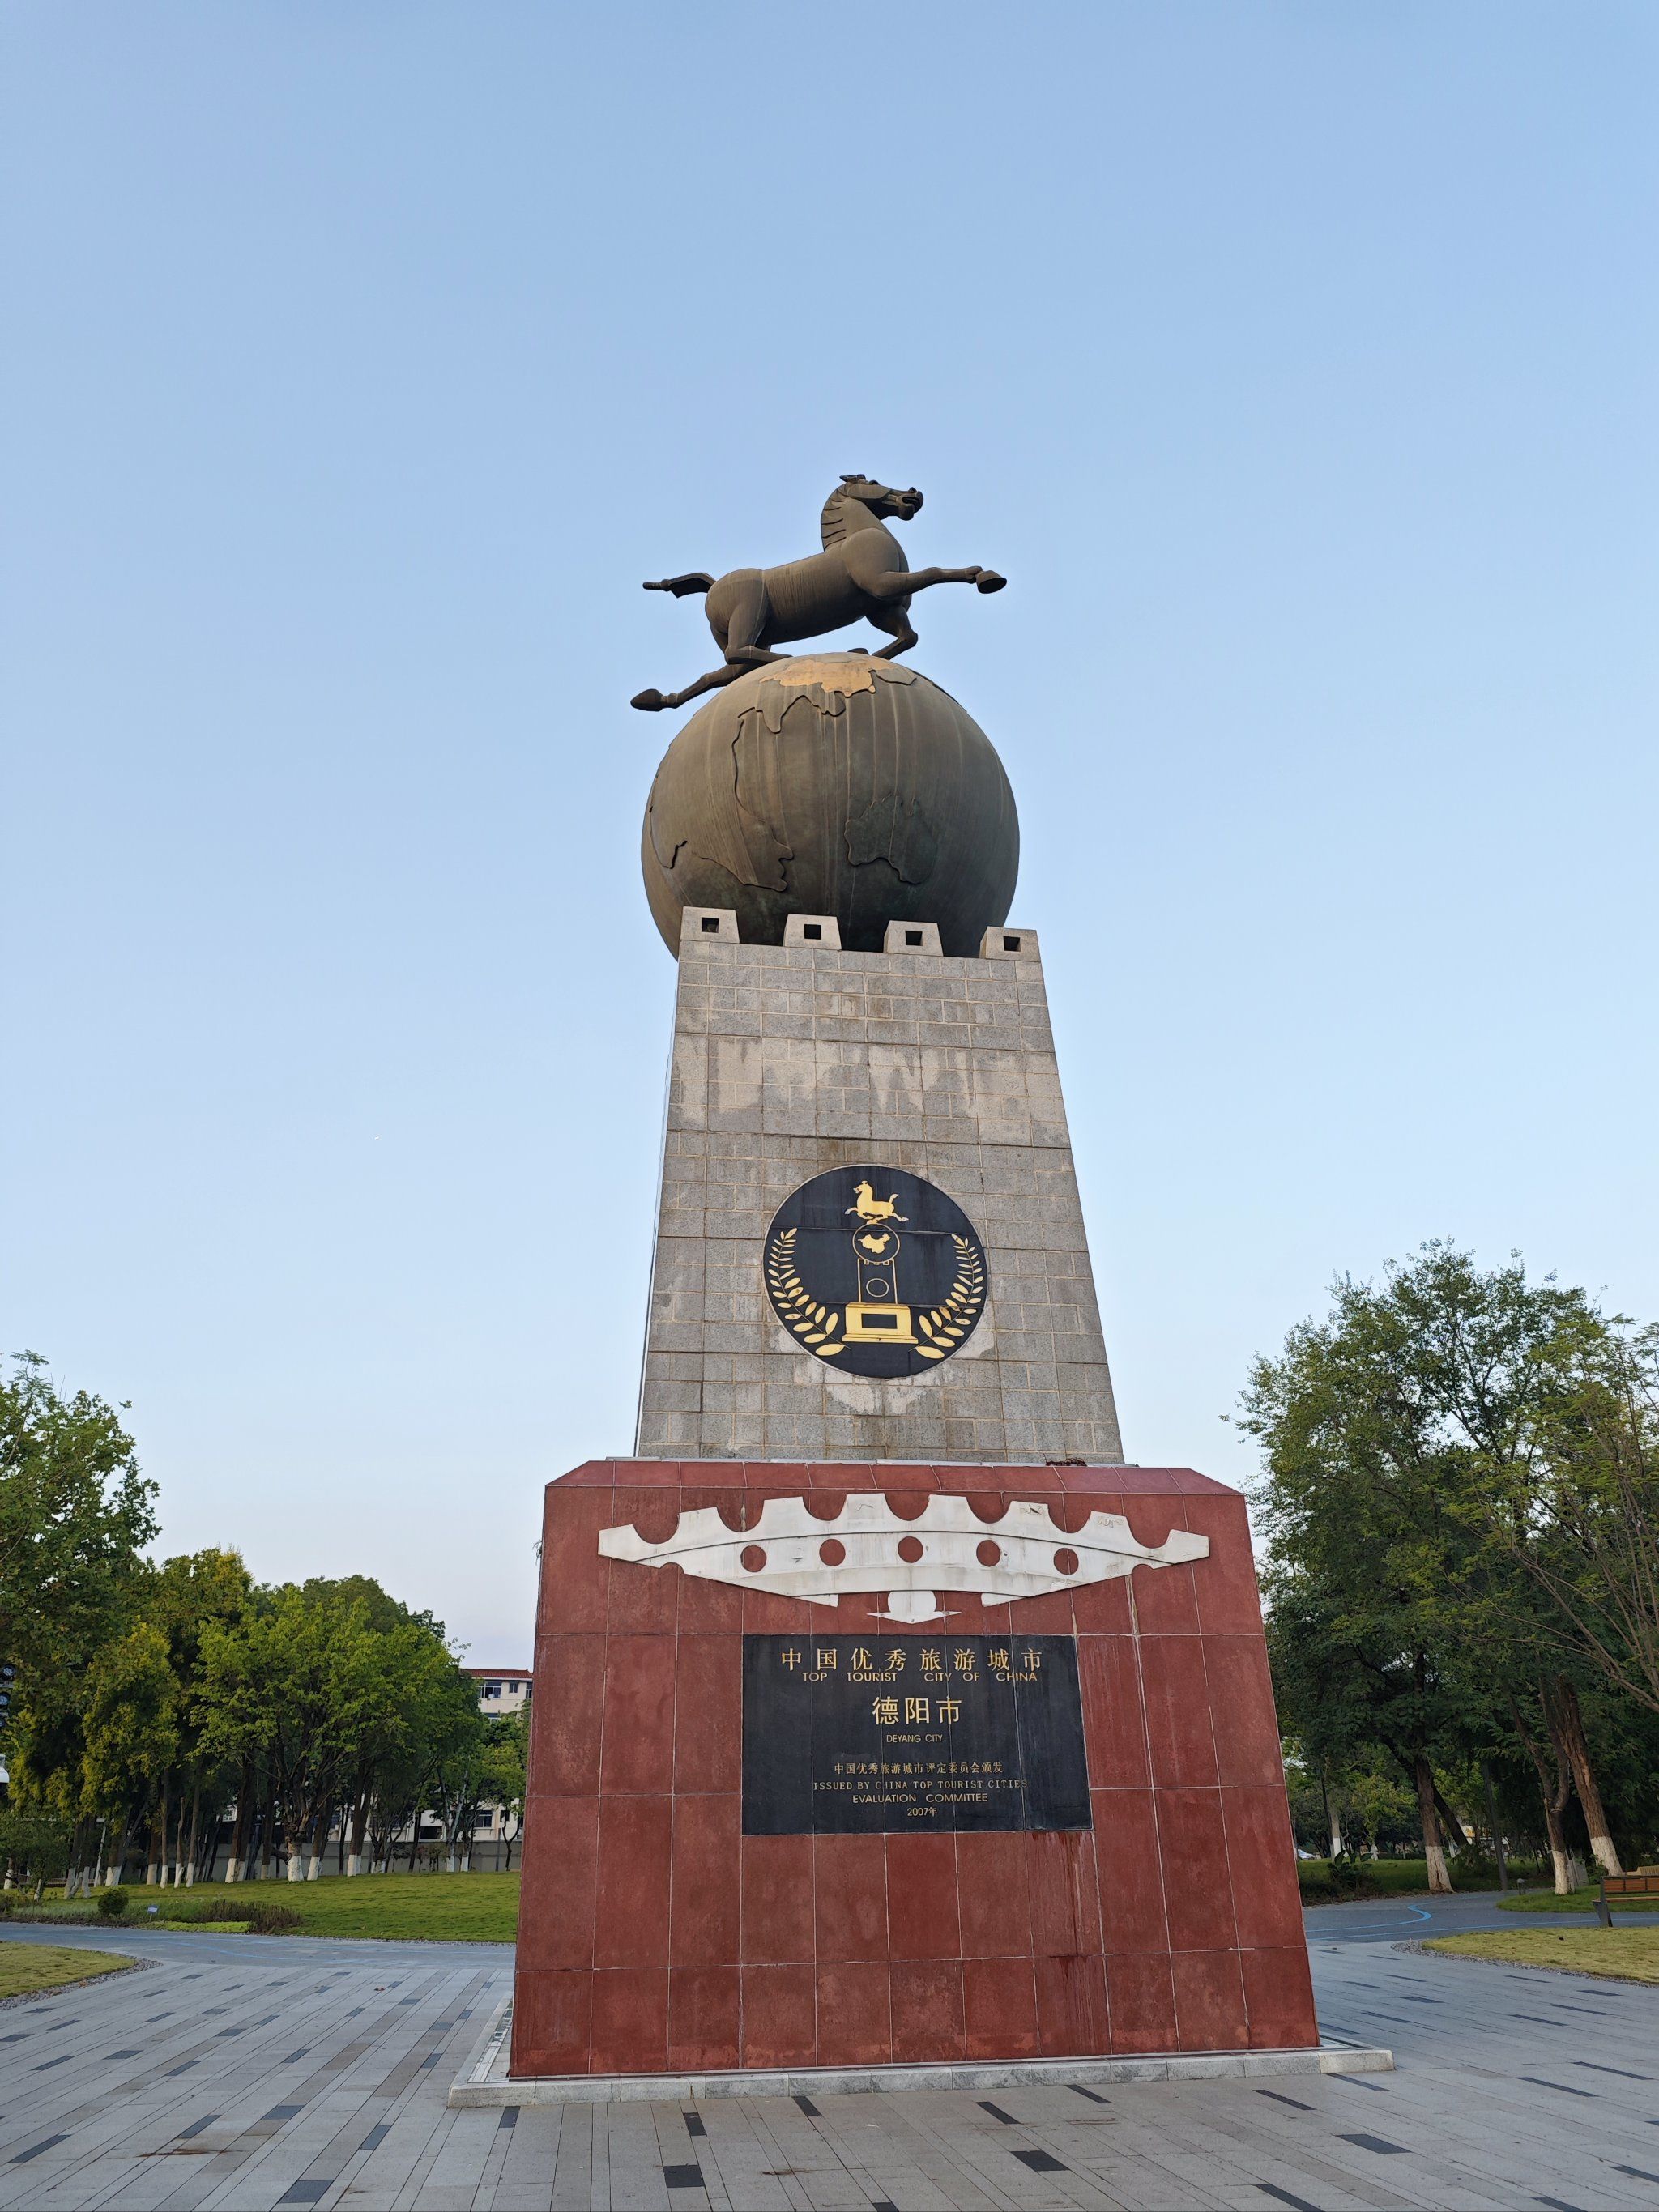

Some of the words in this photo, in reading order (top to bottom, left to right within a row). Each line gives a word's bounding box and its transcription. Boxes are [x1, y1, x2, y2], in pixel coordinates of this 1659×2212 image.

[782, 1647, 1042, 1672] 中国优秀旅游城市
[802, 1672, 827, 1681] TOP
[847, 1672, 898, 1681] TOURIST
[923, 1672, 952, 1681] CITY
[962, 1672, 979, 1681] OF
[996, 1672, 1038, 1681] CHINA
[872, 1695, 962, 1725] 德阳市
[886, 1734, 921, 1743] DEYANG
[925, 1733, 943, 1743] CITY
[834, 1762, 1003, 1775] 中国优秀旅游城市评定委员会颁发
[813, 1782, 852, 1790] ISSUED
[857, 1781, 870, 1789] BY
[875, 1781, 908, 1789] CHINA
[913, 1781, 933, 1789] TOP
[938, 1780, 983, 1788] TOURIST
[987, 1779, 1028, 1788] CITIES
[852, 1794, 916, 1803] EVALUATION
[926, 1793, 987, 1802] COMMITTEE
[907, 1807, 937, 1817] 2007年
